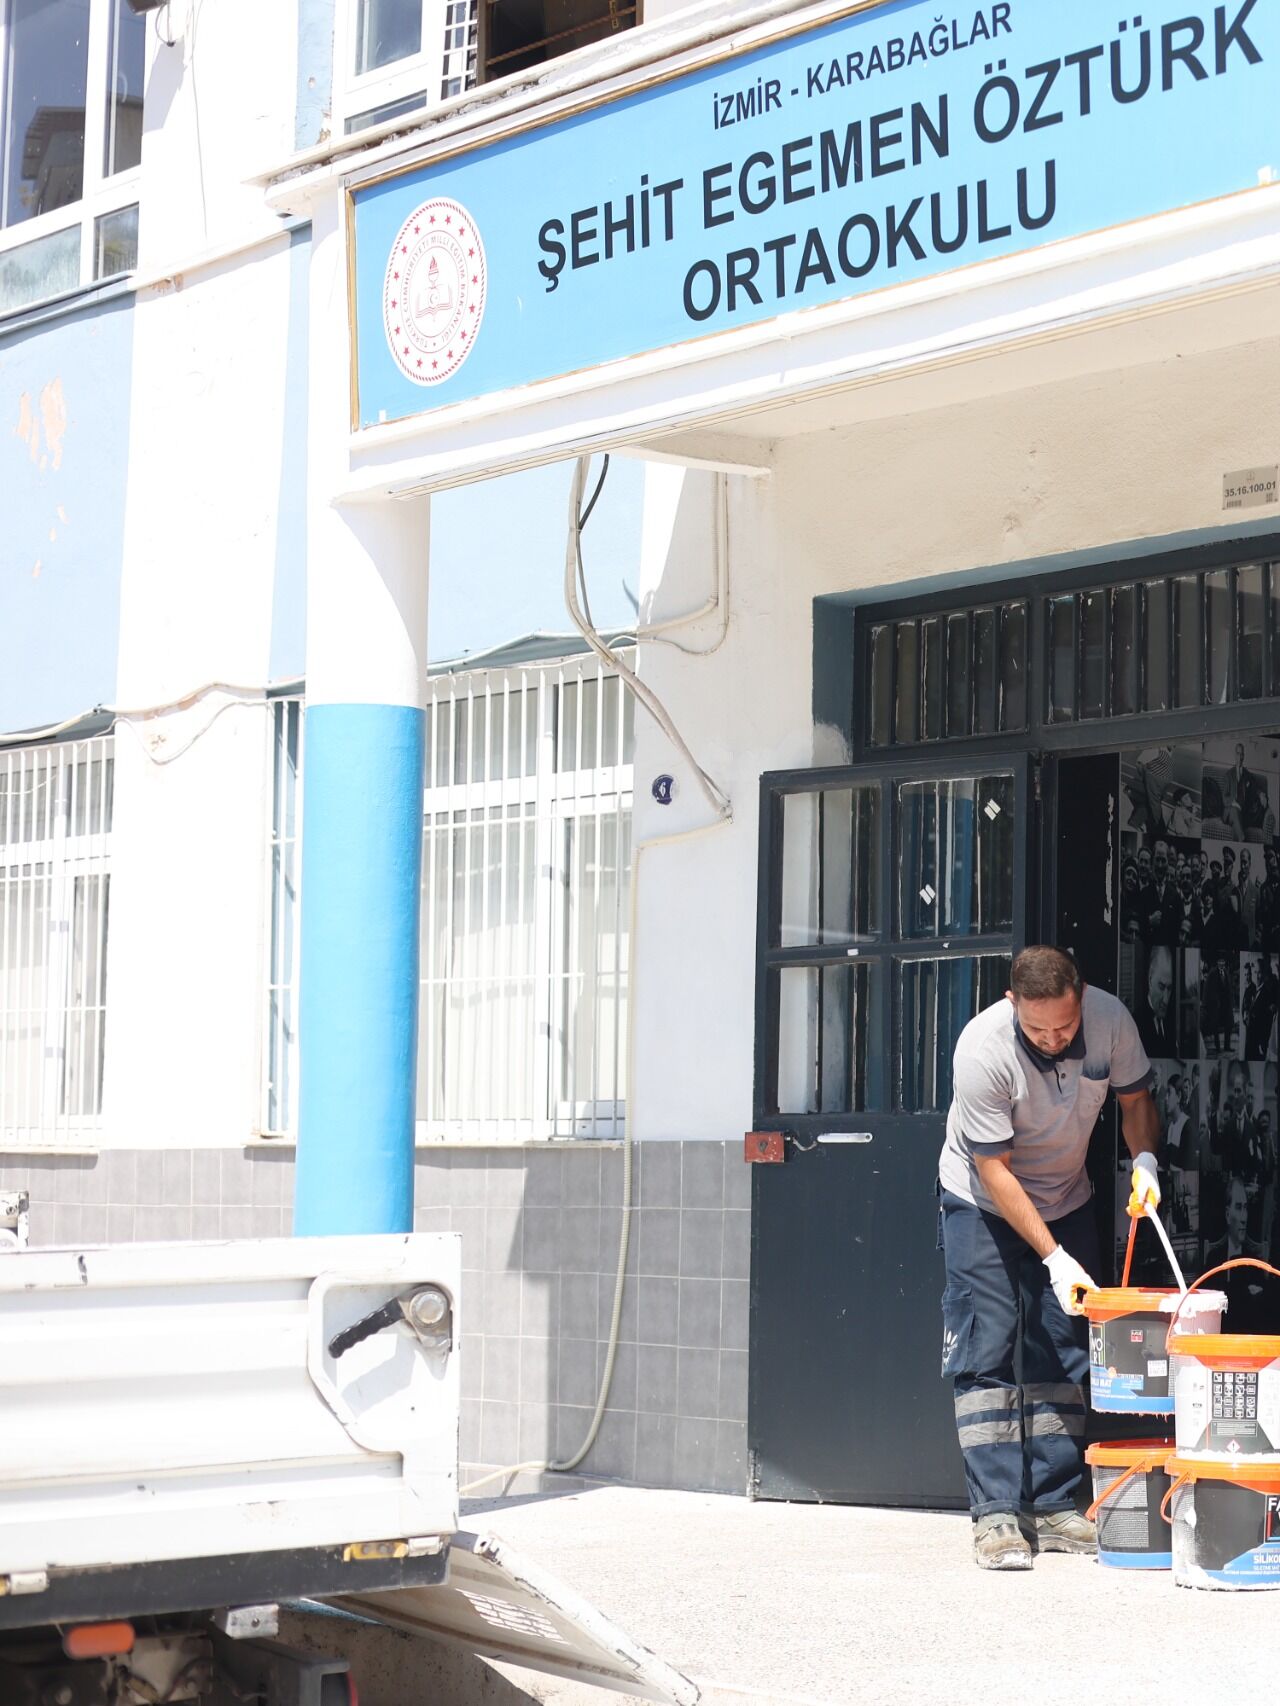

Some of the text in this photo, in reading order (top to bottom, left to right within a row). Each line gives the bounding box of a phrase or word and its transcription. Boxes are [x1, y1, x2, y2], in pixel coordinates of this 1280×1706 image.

[714, 76, 783, 130] İZMİR
[807, 2, 1013, 99] KARABAĞLAR
[537, 0, 1262, 294] ŞEHİT EGEMEN ÖZTÜRK
[683, 159, 1056, 321] ORTAOKULU
[1224, 480, 1277, 498] 35.16.100.01
